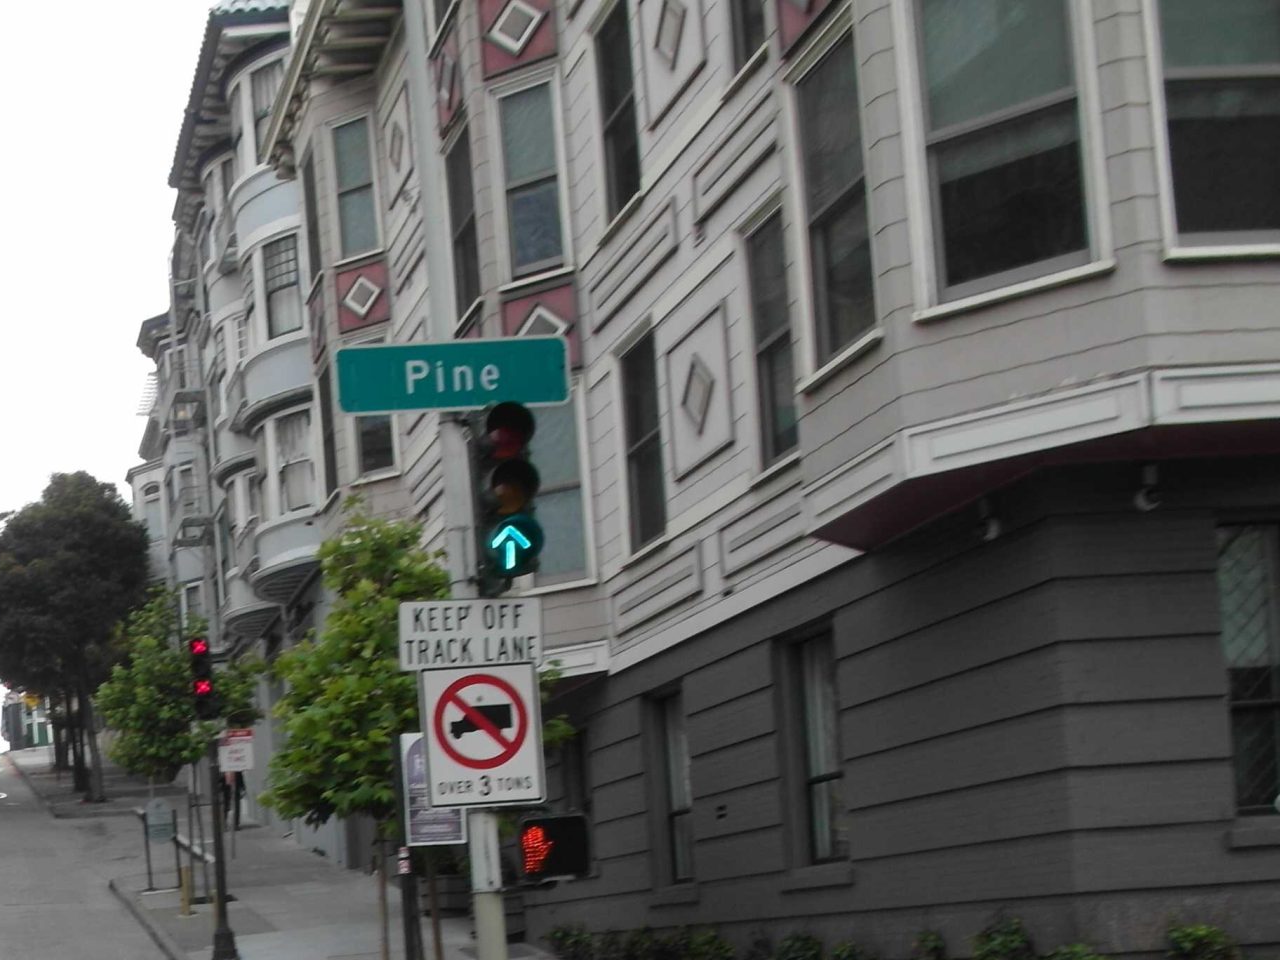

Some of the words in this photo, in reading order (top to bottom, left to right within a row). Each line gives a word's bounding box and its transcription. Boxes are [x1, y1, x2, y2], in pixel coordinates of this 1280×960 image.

[405, 359, 501, 395] Pine
[412, 606, 470, 633] KEEP
[482, 603, 525, 630] OFF
[405, 638, 474, 665] TRACK
[484, 635, 538, 662] LANE
[437, 780, 475, 796] OVER
[478, 775, 492, 797] 3
[497, 775, 534, 791] TONS
